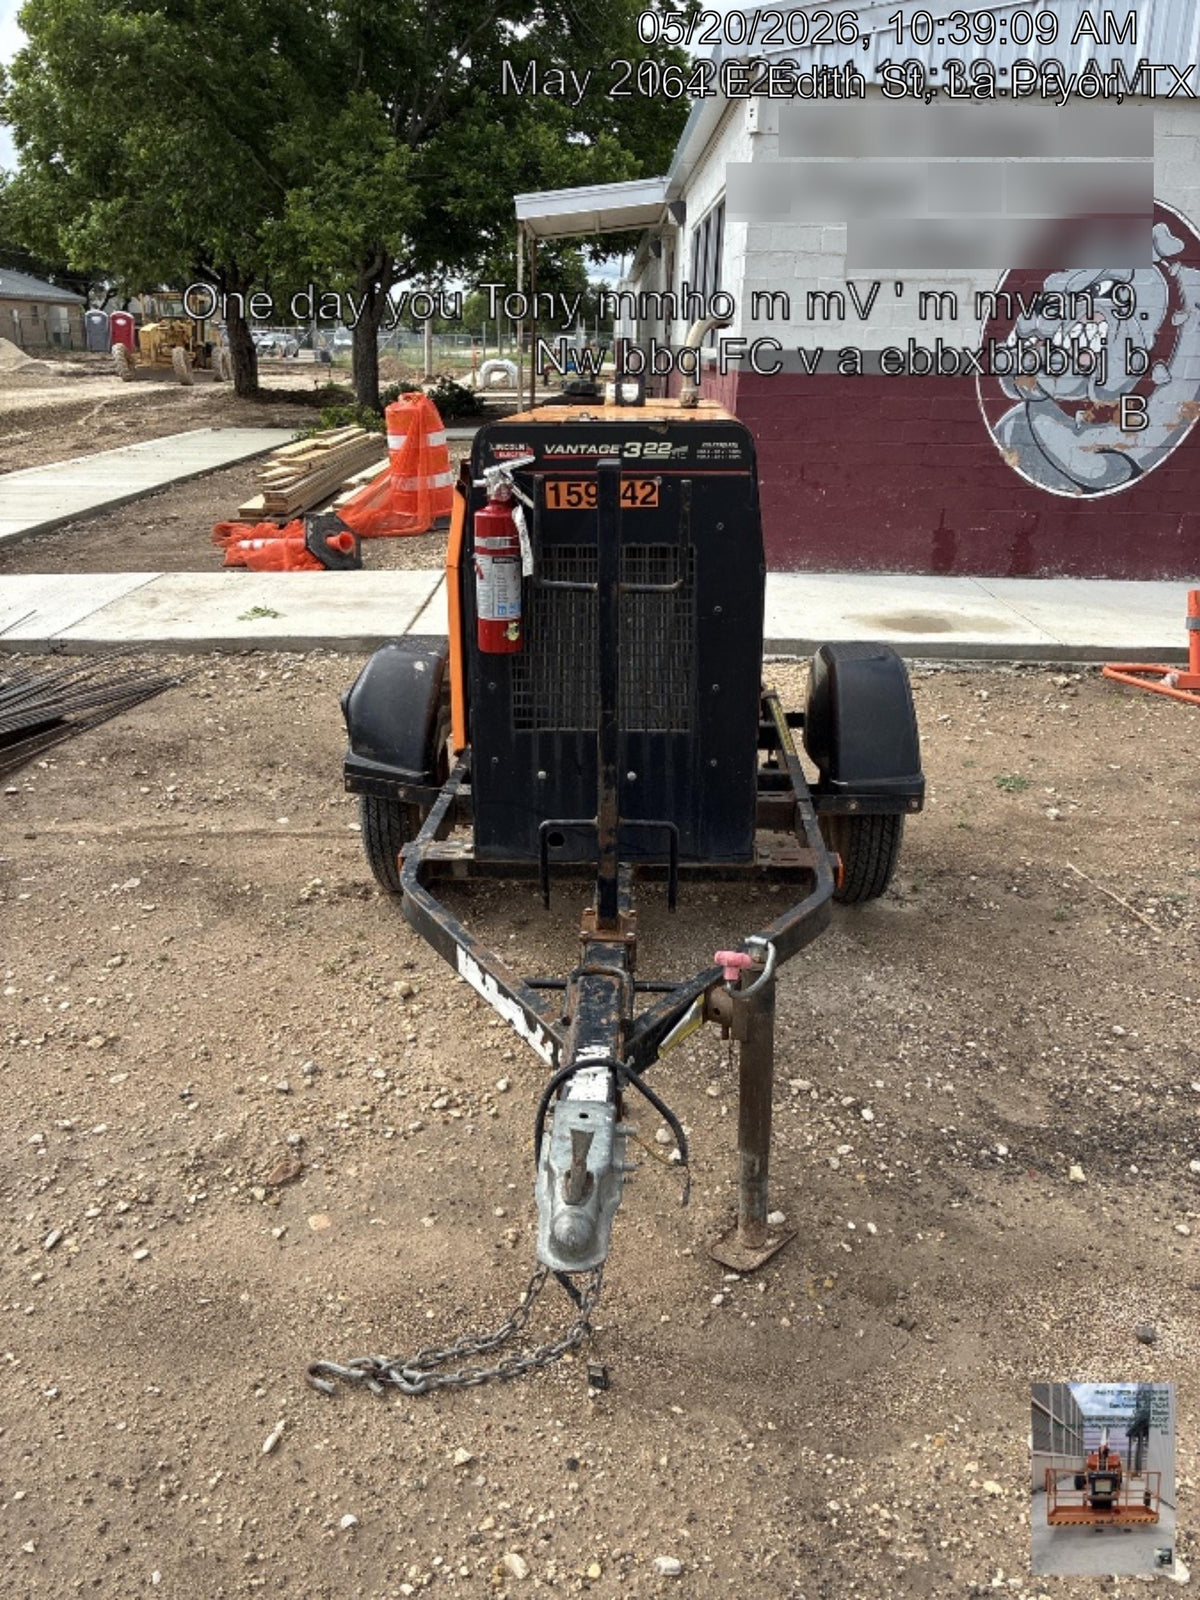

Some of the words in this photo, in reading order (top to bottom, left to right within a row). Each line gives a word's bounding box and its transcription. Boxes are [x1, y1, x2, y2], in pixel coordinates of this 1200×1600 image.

[544, 443, 621, 454] VANTAGE
[623, 441, 673, 458] 322
[548, 481, 657, 507] 15942
